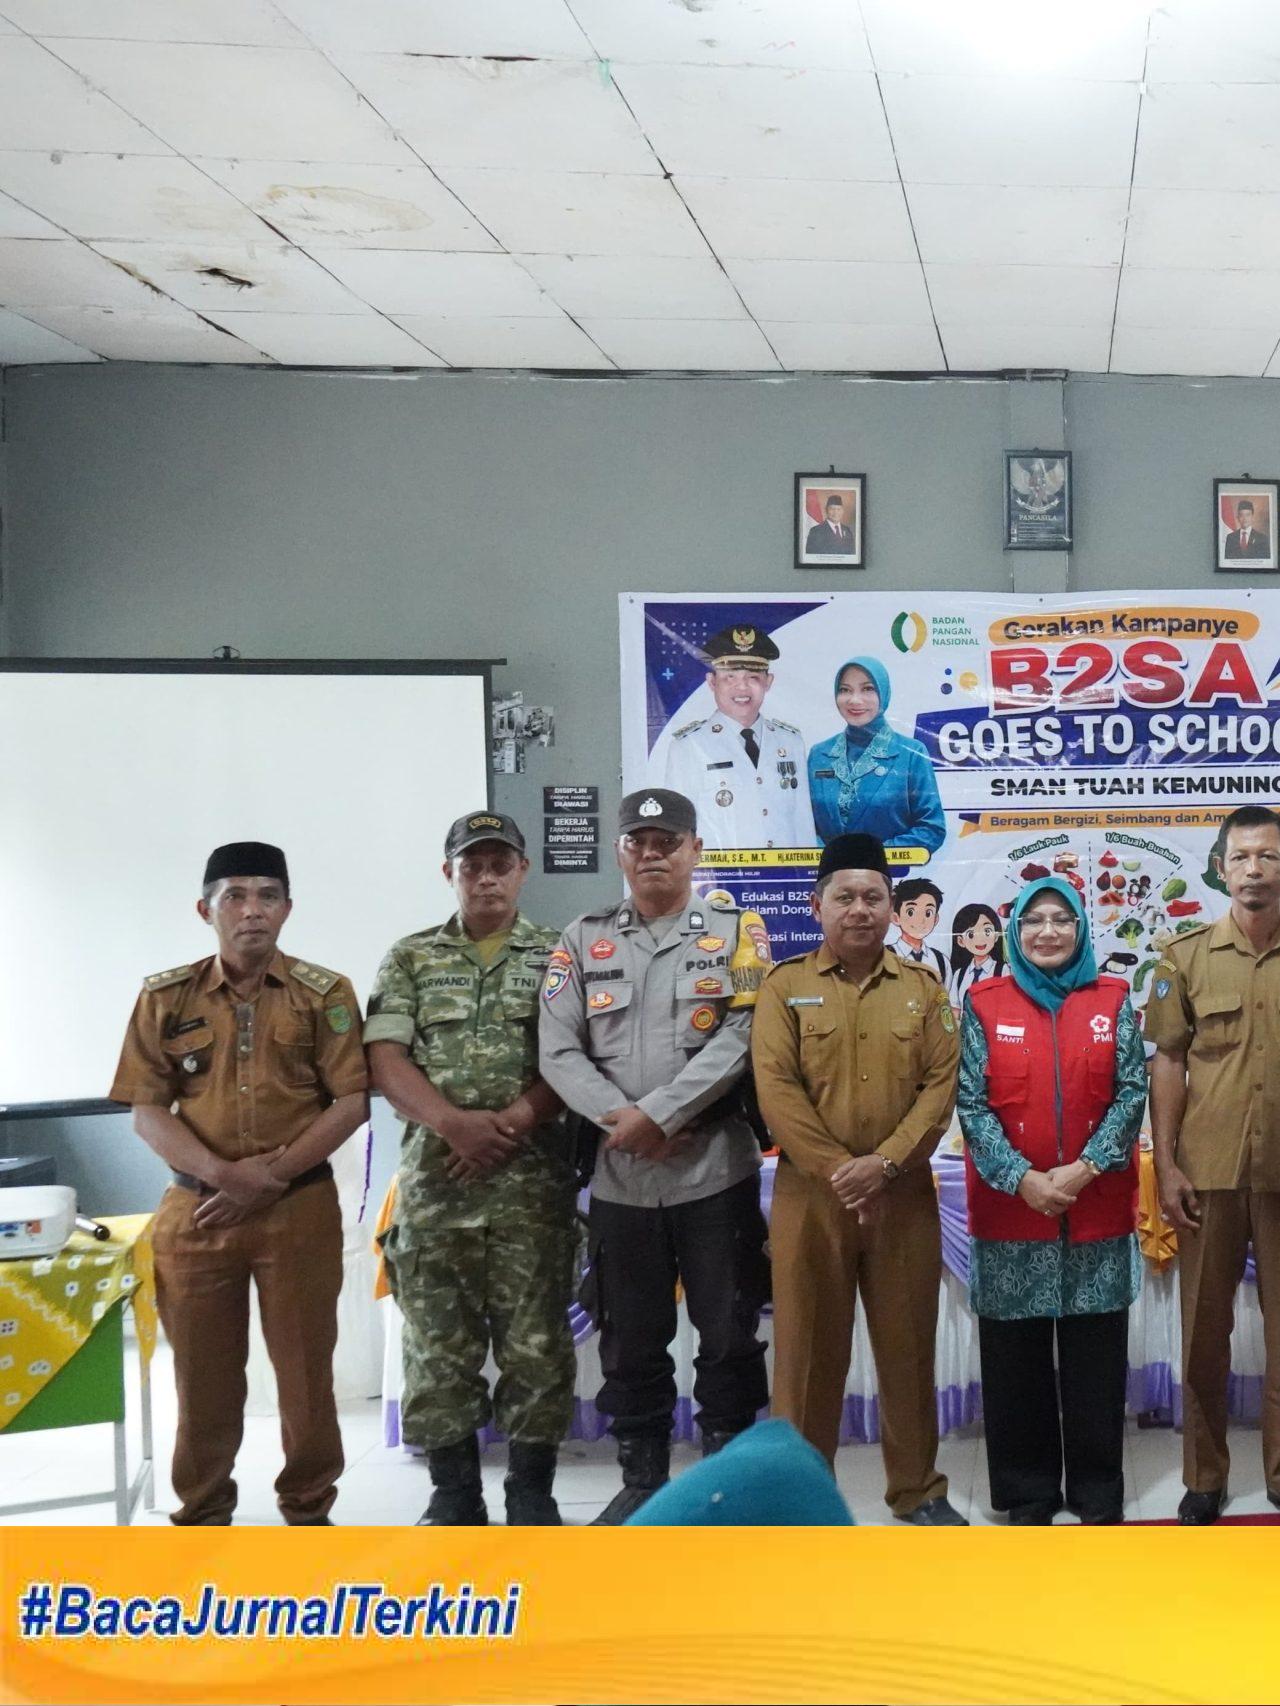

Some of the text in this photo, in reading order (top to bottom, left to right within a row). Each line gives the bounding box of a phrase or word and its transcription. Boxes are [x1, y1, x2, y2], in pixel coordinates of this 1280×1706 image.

[932, 616, 965, 625] BADAN
[932, 627, 972, 635] PANGAN
[1003, 613, 1239, 641] Gerakan Kampanye
[932, 638, 980, 646] NASIONAL
[990, 640, 1264, 712] B2SA
[938, 716, 1063, 762] GOES
[1073, 714, 1134, 755] TO
[990, 777, 1066, 796] SMAN
[1073, 777, 1145, 796] TUAH
[554, 818, 589, 826] BEKERJA
[991, 815, 1050, 828] Beragam
[1106, 813, 1172, 826] Seimbang
[1175, 812, 1200, 823] dan
[1203, 812, 1226, 823] Am
[548, 834, 595, 843] DIPERINTAH
[1044, 834, 1070, 847] Pauk
[700, 853, 730, 864] ERMAN,
[751, 853, 767, 862] M.T.
[741, 890, 811, 902] Edukasi B2S
[781, 904, 813, 916] Dong
[791, 931, 825, 941] Intera
[686, 955, 730, 972] POLRI
[512, 977, 536, 988] TNI
[996, 1034, 1025, 1044] SANTI
[1093, 1033, 1113, 1044] PMI
